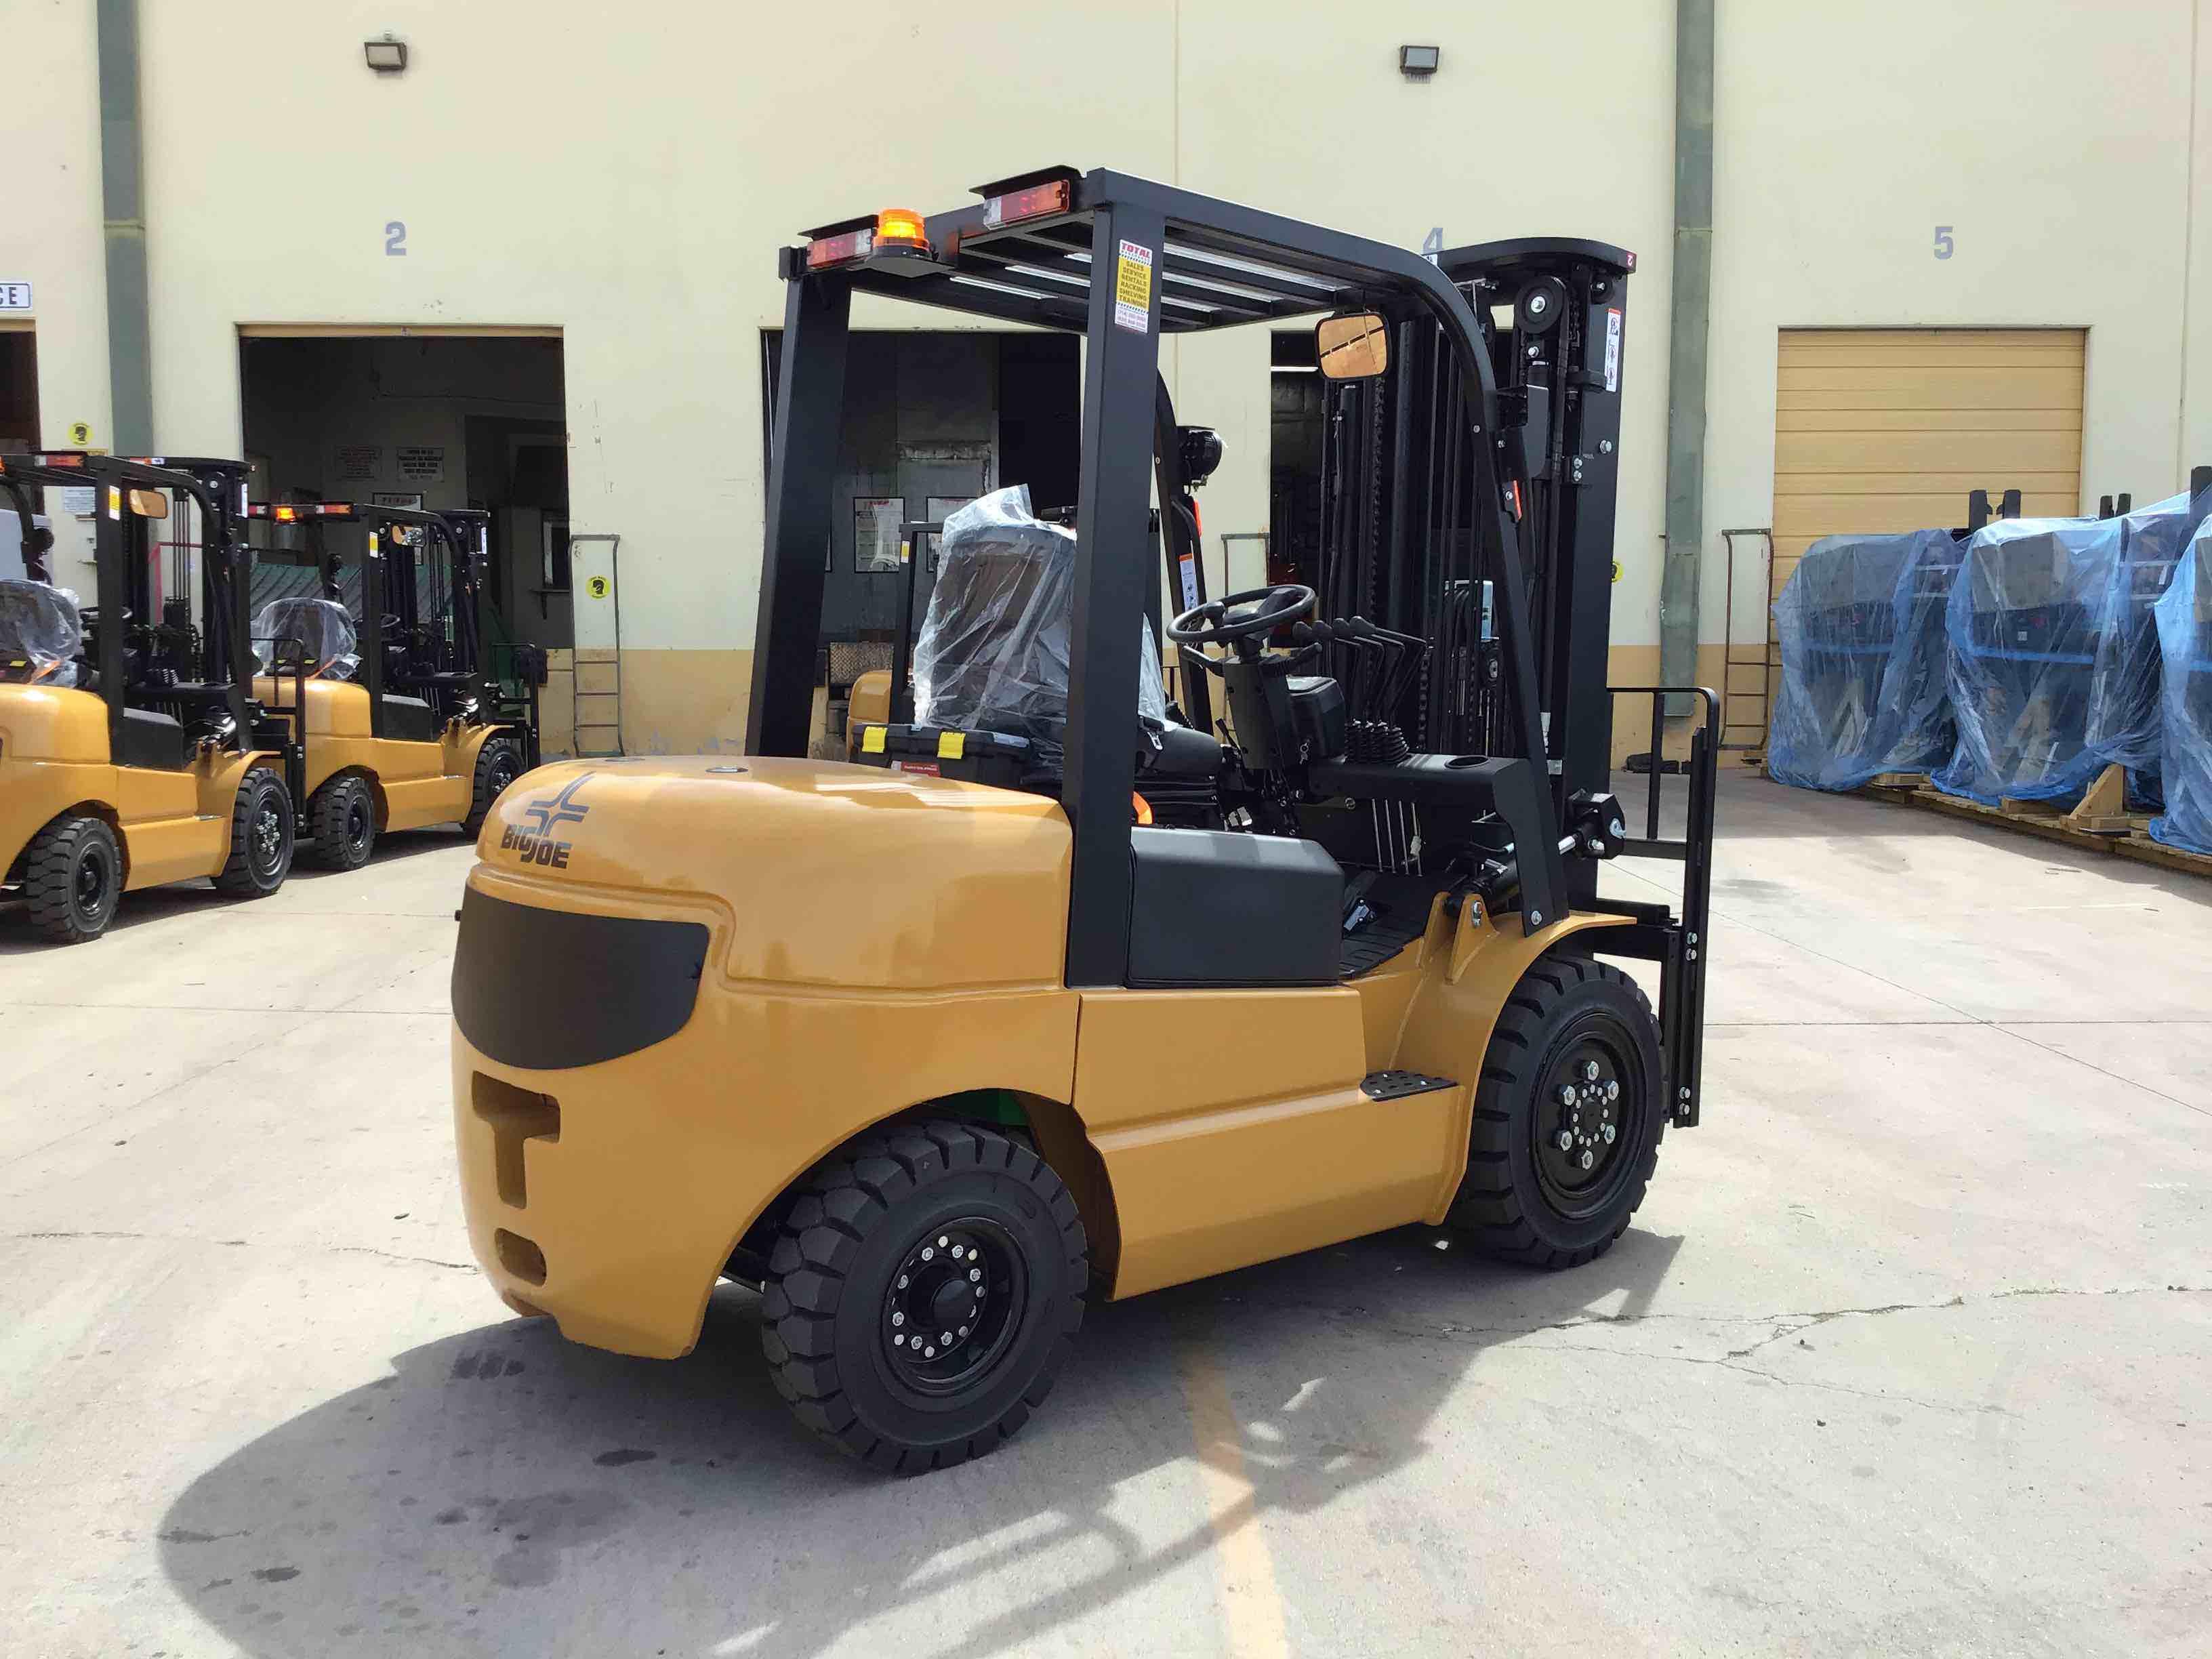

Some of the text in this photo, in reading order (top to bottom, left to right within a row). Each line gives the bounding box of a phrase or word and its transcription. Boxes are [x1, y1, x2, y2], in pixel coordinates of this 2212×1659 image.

[386, 221, 406, 256] 2
[1422, 227, 1443, 254] 4
[1934, 226, 1953, 260] 5
[1121, 243, 1150, 258] TOTAL
[1122, 266, 1147, 279] SERVICE
[1126, 260, 1145, 271] SALES
[1120, 281, 1147, 293] RACKING
[1121, 274, 1147, 286] RENTALS
[1119, 287, 1147, 301] SHELVING
[1119, 295, 1146, 308] TRAINING
[501, 823, 572, 869] BIG JOE
